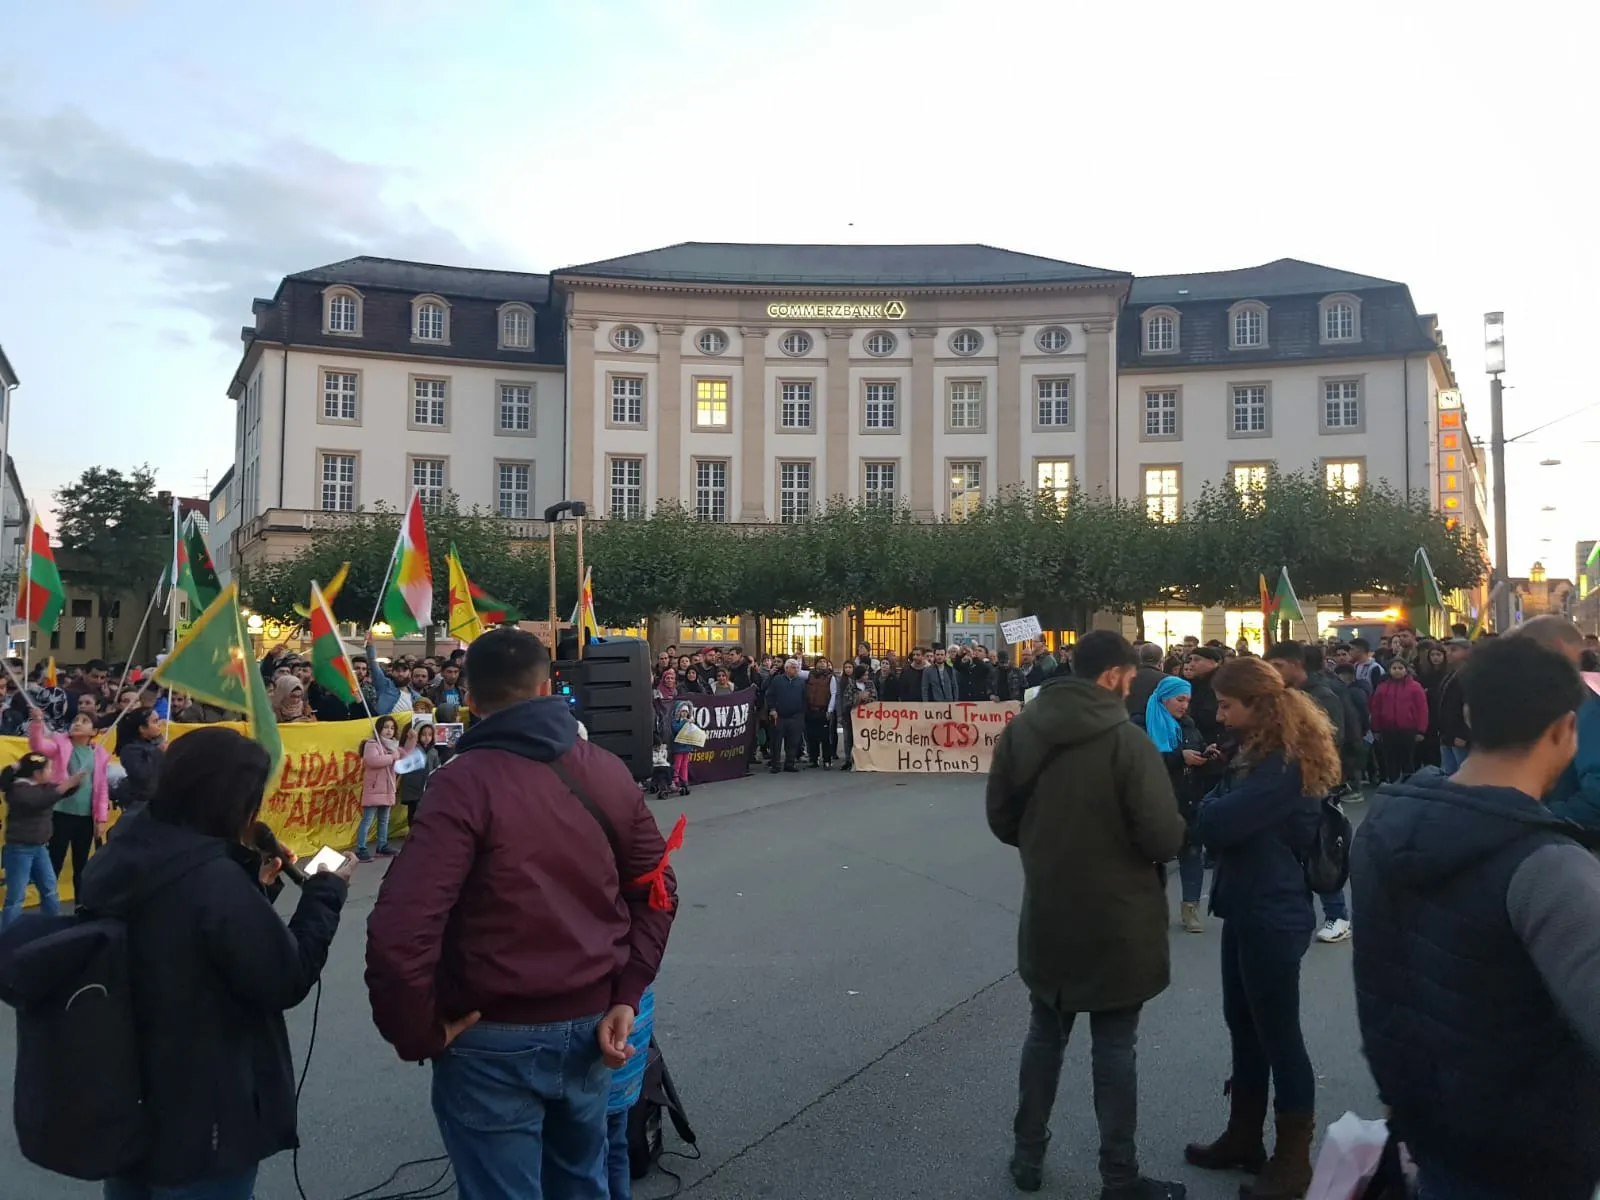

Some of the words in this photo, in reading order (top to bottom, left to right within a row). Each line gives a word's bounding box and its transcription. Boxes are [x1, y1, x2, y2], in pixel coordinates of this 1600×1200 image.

[768, 303, 882, 318] COMMERZBANK
[856, 703, 918, 729] Erdogan
[925, 703, 952, 720] und
[860, 725, 903, 751] geben
[905, 726, 930, 747] dem
[898, 748, 979, 771] Hoffnung
